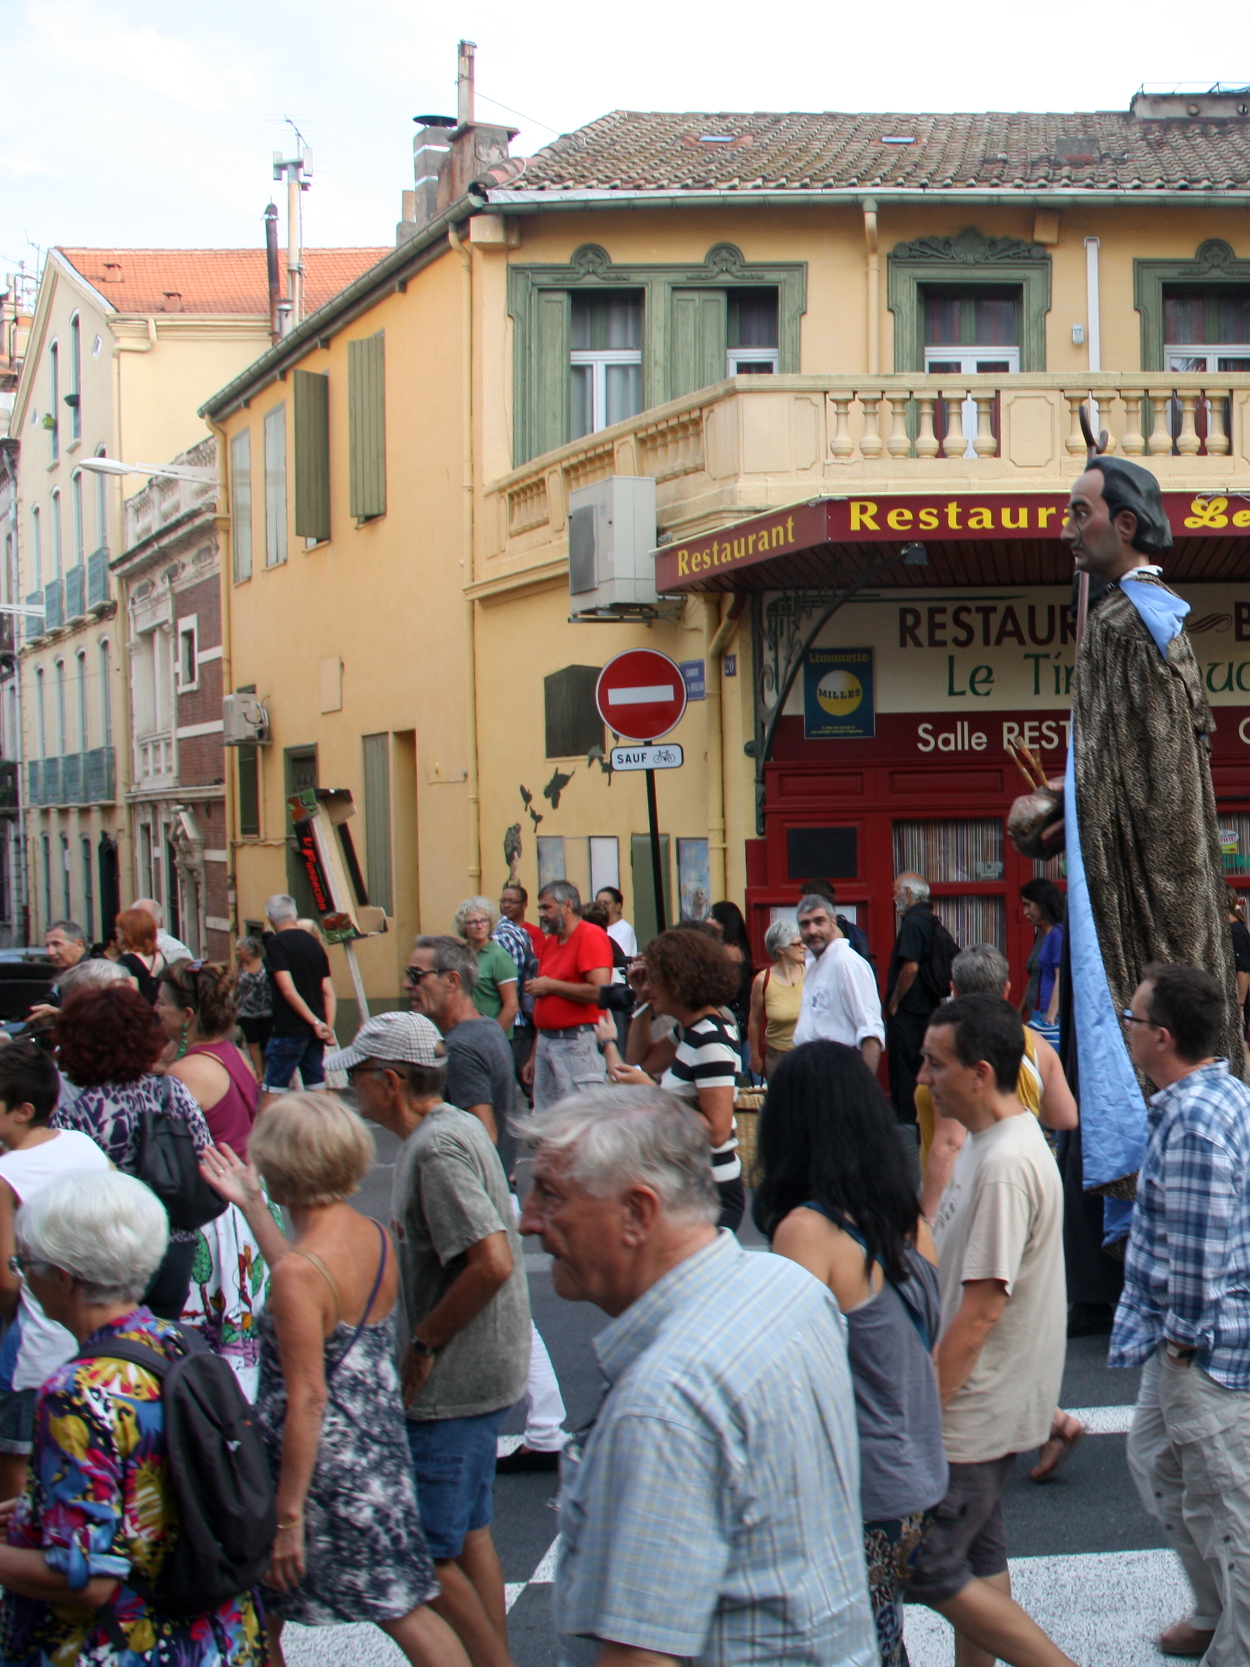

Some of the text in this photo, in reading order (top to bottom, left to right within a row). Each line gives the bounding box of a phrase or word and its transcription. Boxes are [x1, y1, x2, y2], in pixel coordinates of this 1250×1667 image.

[677, 516, 796, 577] Restaurant
[725, 658, 735, 674] 20
[808, 653, 869, 663] Limonette
[947, 654, 995, 698] Le
[818, 688, 861, 700] MILLES
[917, 722, 988, 753] Salle
[617, 753, 648, 764] SAUF
